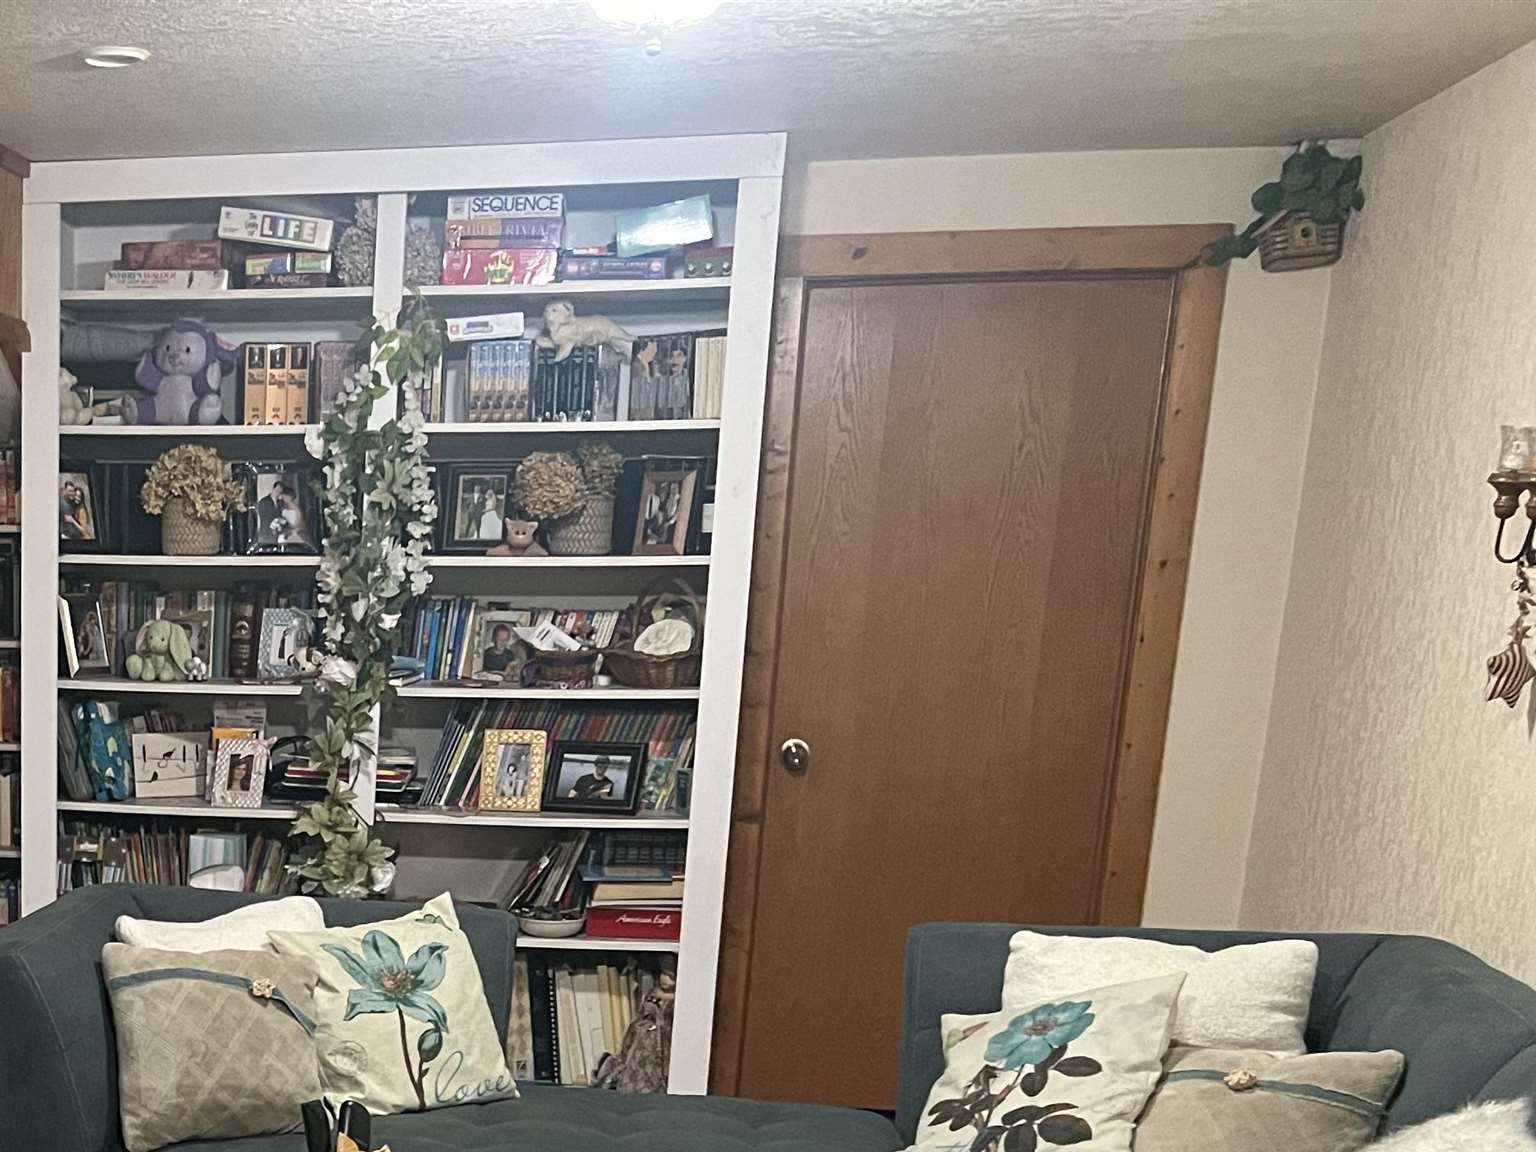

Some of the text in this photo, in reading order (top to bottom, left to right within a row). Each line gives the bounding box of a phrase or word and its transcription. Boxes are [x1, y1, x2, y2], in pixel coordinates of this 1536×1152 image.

[472, 195, 560, 213] SEQUENCE
[262, 215, 317, 241] LIFE
[435, 1050, 511, 1103] love
